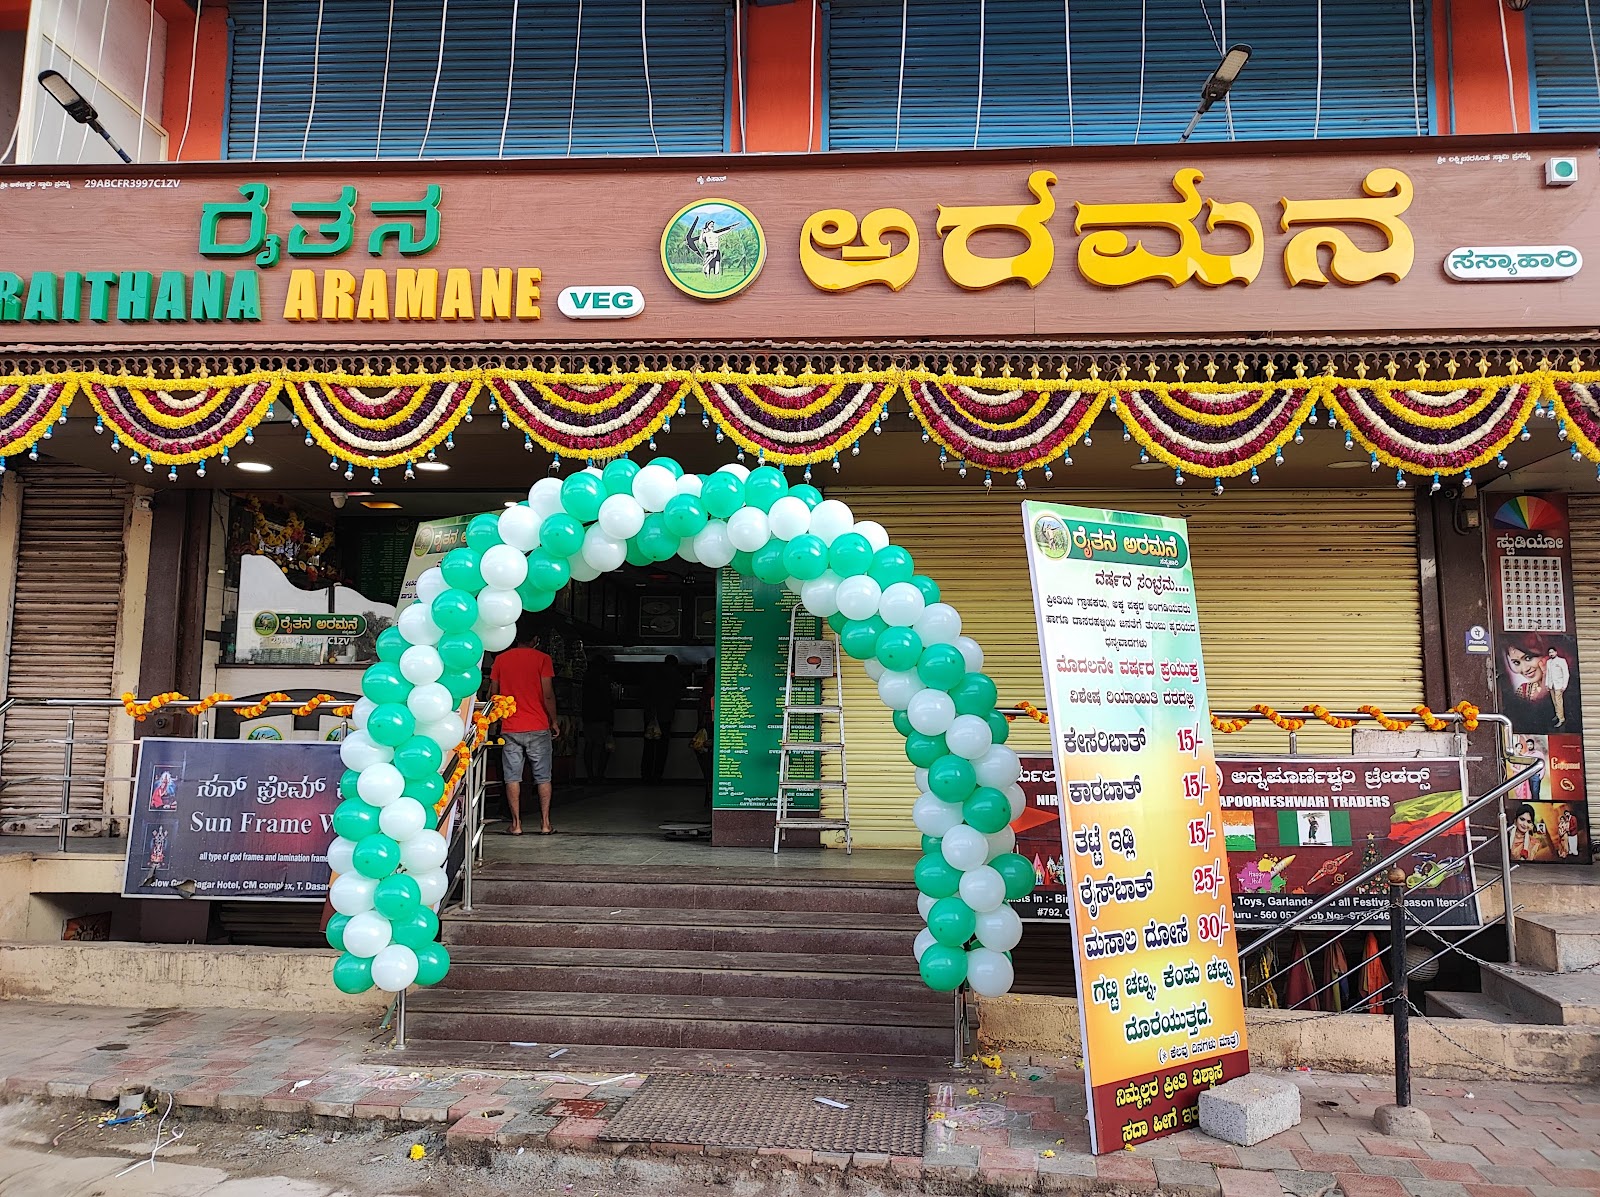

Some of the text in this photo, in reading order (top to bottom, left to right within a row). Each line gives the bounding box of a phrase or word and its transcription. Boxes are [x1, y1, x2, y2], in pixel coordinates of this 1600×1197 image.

[84, 179, 181, 188] 29ABCFR3997C1ZV
[199, 167, 1415, 293] ರೈತನ ಅರಮನೆ
[1452, 247, 1579, 276] ಸಸ್ಯಾಹಾರಿ
[0, 267, 542, 321] RAITHANA ARAMANE
[569, 292, 634, 310] VEG
[1072, 525, 1179, 559] ರೈತನ ಅರಮನೆ
[1496, 532, 1564, 555] ಸ್ಟುಡಿಯೋ
[1095, 569, 1132, 588] ವರ್ಷದ
[1046, 594, 1074, 608] ಪ್ರೀತಿಯ
[280, 616, 358, 634] ರೈತನ ಅರಮನೆ
[1046, 614, 1069, 625] ಹಾಗೂ
[1105, 637, 1148, 651] ಧನ್ಯವಾದಗಳು
[1056, 654, 1200, 683] ಮೊದಲನೇ ವರ್ಷದ ಪ್ರಯುಕ್ತ
[1069, 688, 1195, 710] ವಿಶೇಷ ರಿಯಾಯಿತಿ ದರದಲ್ಲಿ
[1063, 722, 1203, 758] ಕೇಸರಿಬಾತ್ 15/-
[196, 773, 248, 798] ಸನ್
[256, 774, 327, 805] ಫ್ರೇಮ್
[1069, 767, 1210, 804] ಕಾರಬಾತ್ 15/-
[1221, 795, 1330, 808] APOORNESHWARI
[1331, 795, 1390, 808] TRADERS
[190, 810, 232, 832] Sun
[238, 812, 312, 834] Frame
[1074, 813, 1215, 866] ತಟ್ಟೆ ಇಡ್ಲಿ 15/-
[199, 852, 329, 863] all type of god frames and lamination frame
[148, 879, 169, 888] elow
[217, 881, 241, 890] Hotel,
[242, 881, 257, 889] CM
[296, 882, 304, 890] T.
[305, 882, 329, 891] Dasar
[1193, 860, 1223, 897] 25/-
[1033, 894, 1042, 903] in
[1238, 896, 1266, 908] Toys,
[1268, 896, 1313, 907] Garlands
[1338, 897, 1350, 907] all
[1352, 897, 1390, 908] Festiva
[1404, 899, 1435, 908] eason
[1036, 908, 1063, 917] #792,
[1260, 911, 1278, 920] 560
[1085, 907, 1229, 957] ಮಸಾಲ ದೋಸೆ 30/-
[1093, 975, 1119, 1011] ಗಟ್ಟಿ
[1162, 961, 1200, 988] ಕೆಂಪು
[1206, 957, 1234, 986] ಚಟ್ನಿ
[1125, 1002, 1211, 1041] ದೊರೆಯುತ್ತದೆ.
[1191, 1039, 1216, 1054] ದಿನಗಳು
[1116, 1059, 1223, 1109] ನಿಮ್ಮೆಲ್ಲರ ಪ್ರೀತಿ ವಿಶ್ವಾಸ
[1121, 1104, 1200, 1142] ಸದಾ ಹೀಗೆ ಇರ
